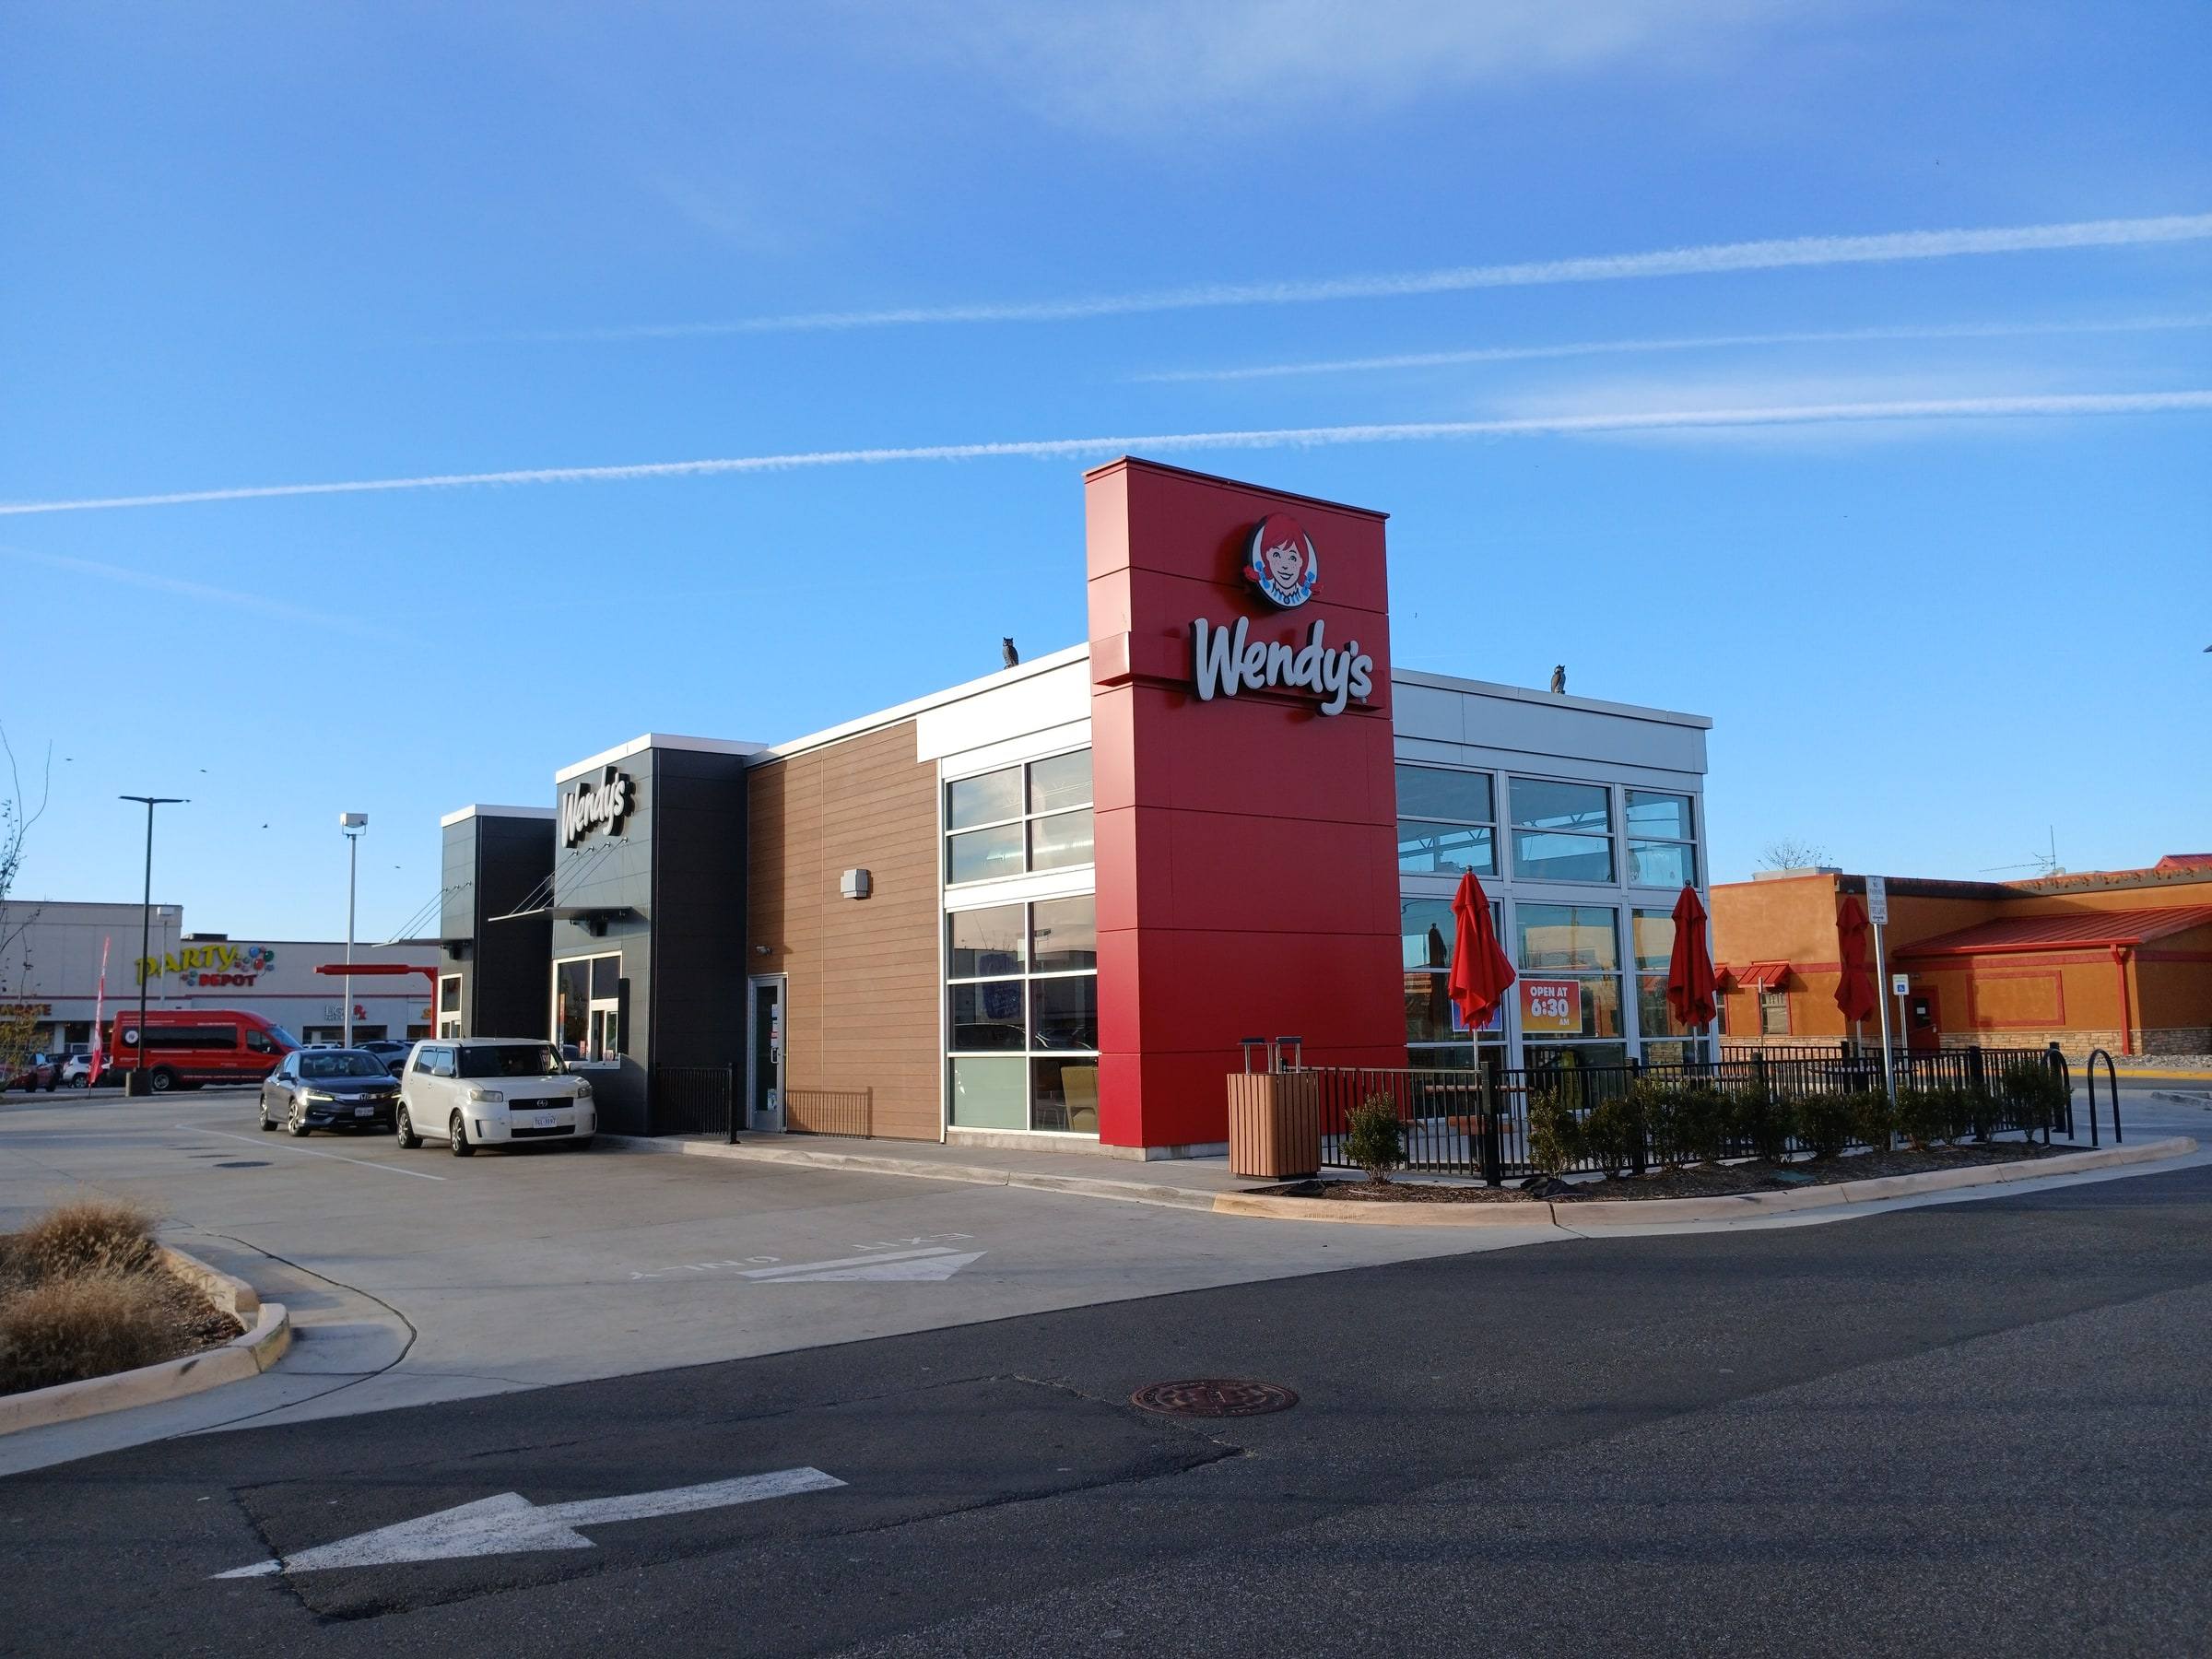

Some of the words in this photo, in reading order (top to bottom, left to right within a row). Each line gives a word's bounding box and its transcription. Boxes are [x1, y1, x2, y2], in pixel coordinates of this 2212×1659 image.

[1193, 616, 1373, 716] Wendy's
[561, 765, 630, 848] Wendy's
[135, 945, 240, 985] PARTY
[198, 973, 257, 987] DEPOT
[1530, 986, 1555, 997] OPEN
[1557, 987, 1568, 997] AT
[1531, 998, 1569, 1018] 6:30
[852, 1232, 974, 1252] EXIT
[629, 1255, 782, 1280] ONLY
